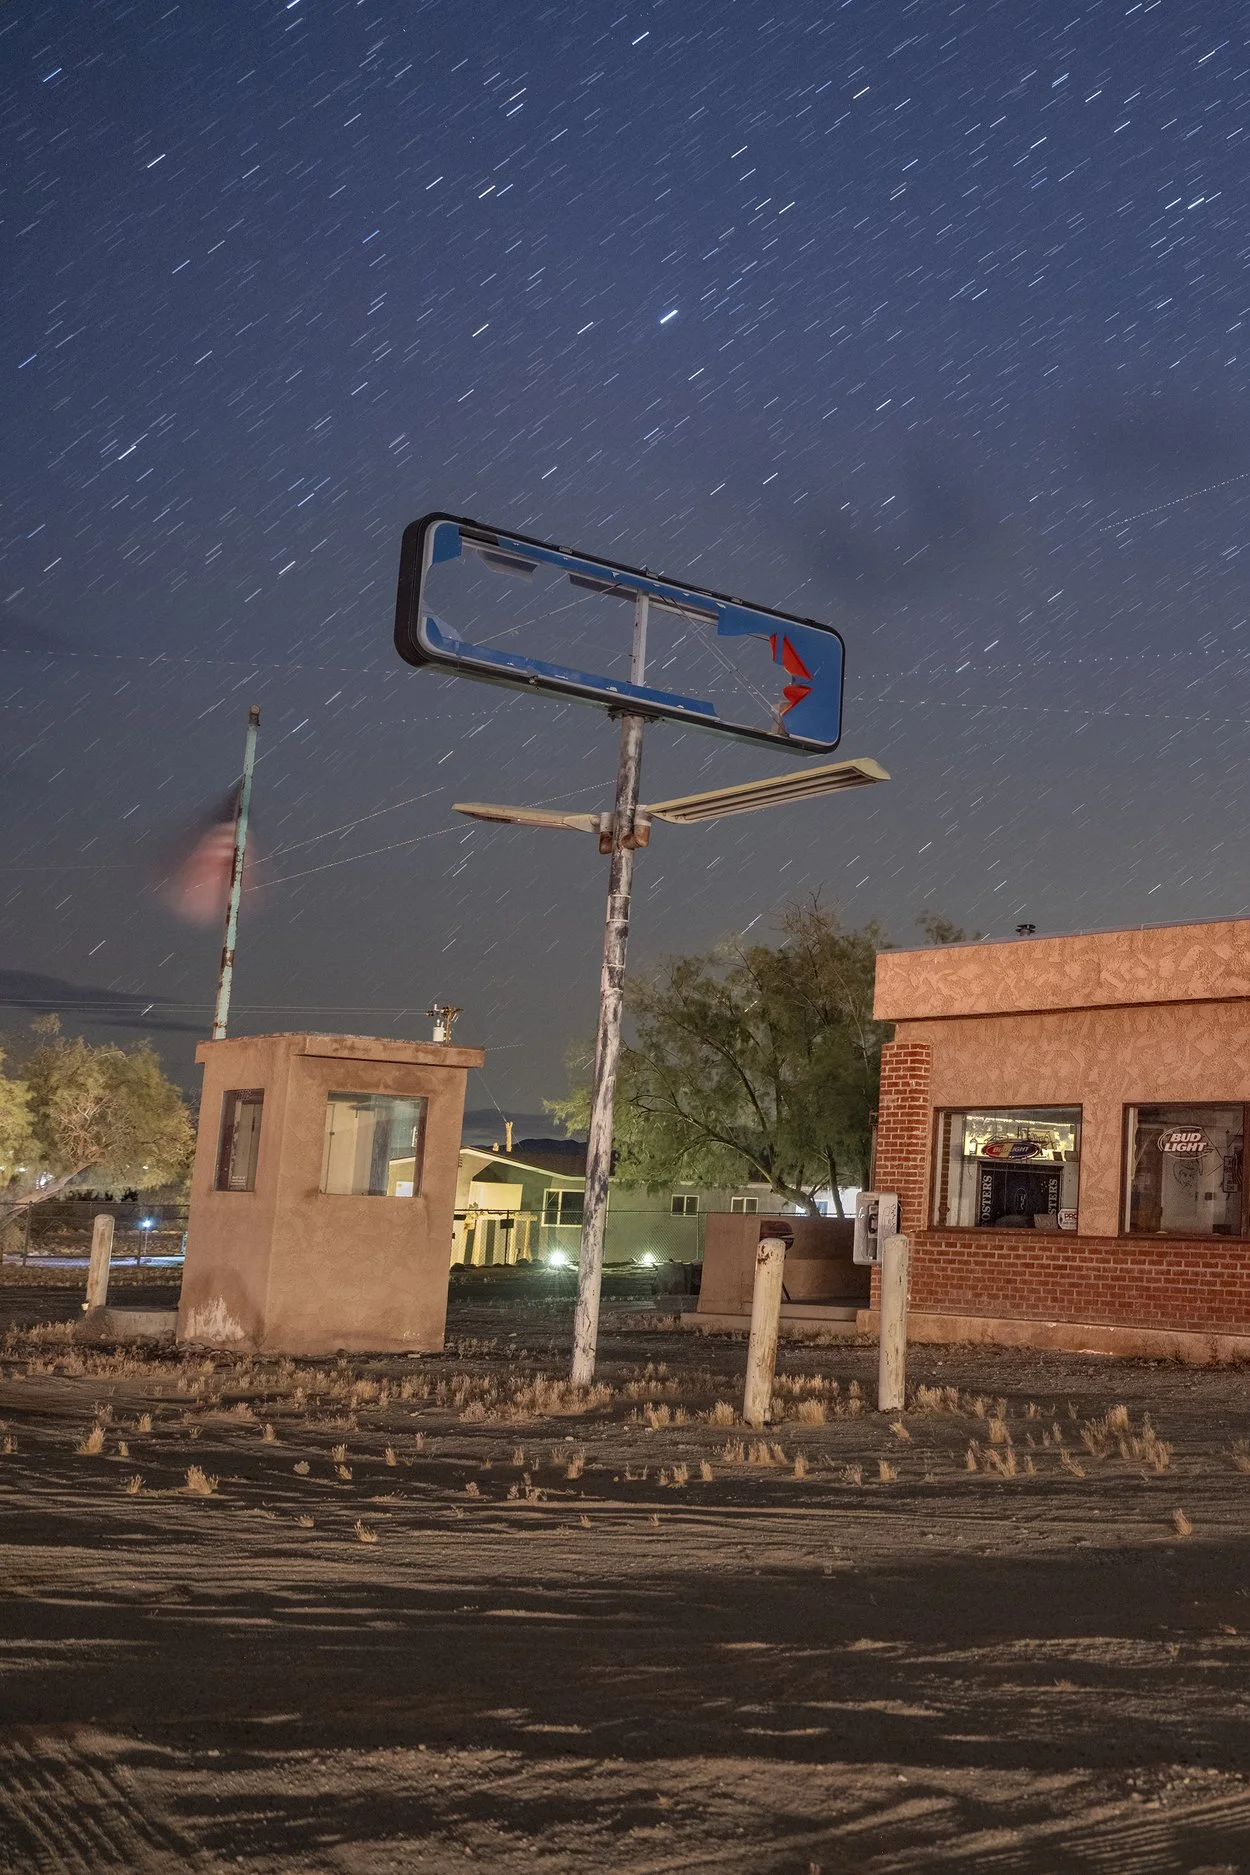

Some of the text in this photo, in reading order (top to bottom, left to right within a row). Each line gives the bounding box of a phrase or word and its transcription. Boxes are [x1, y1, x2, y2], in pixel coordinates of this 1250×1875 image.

[1170, 1132, 1202, 1142] BUD
[1164, 1142, 1207, 1152] LIGHT
[1047, 1178, 1058, 1216] STER'S
